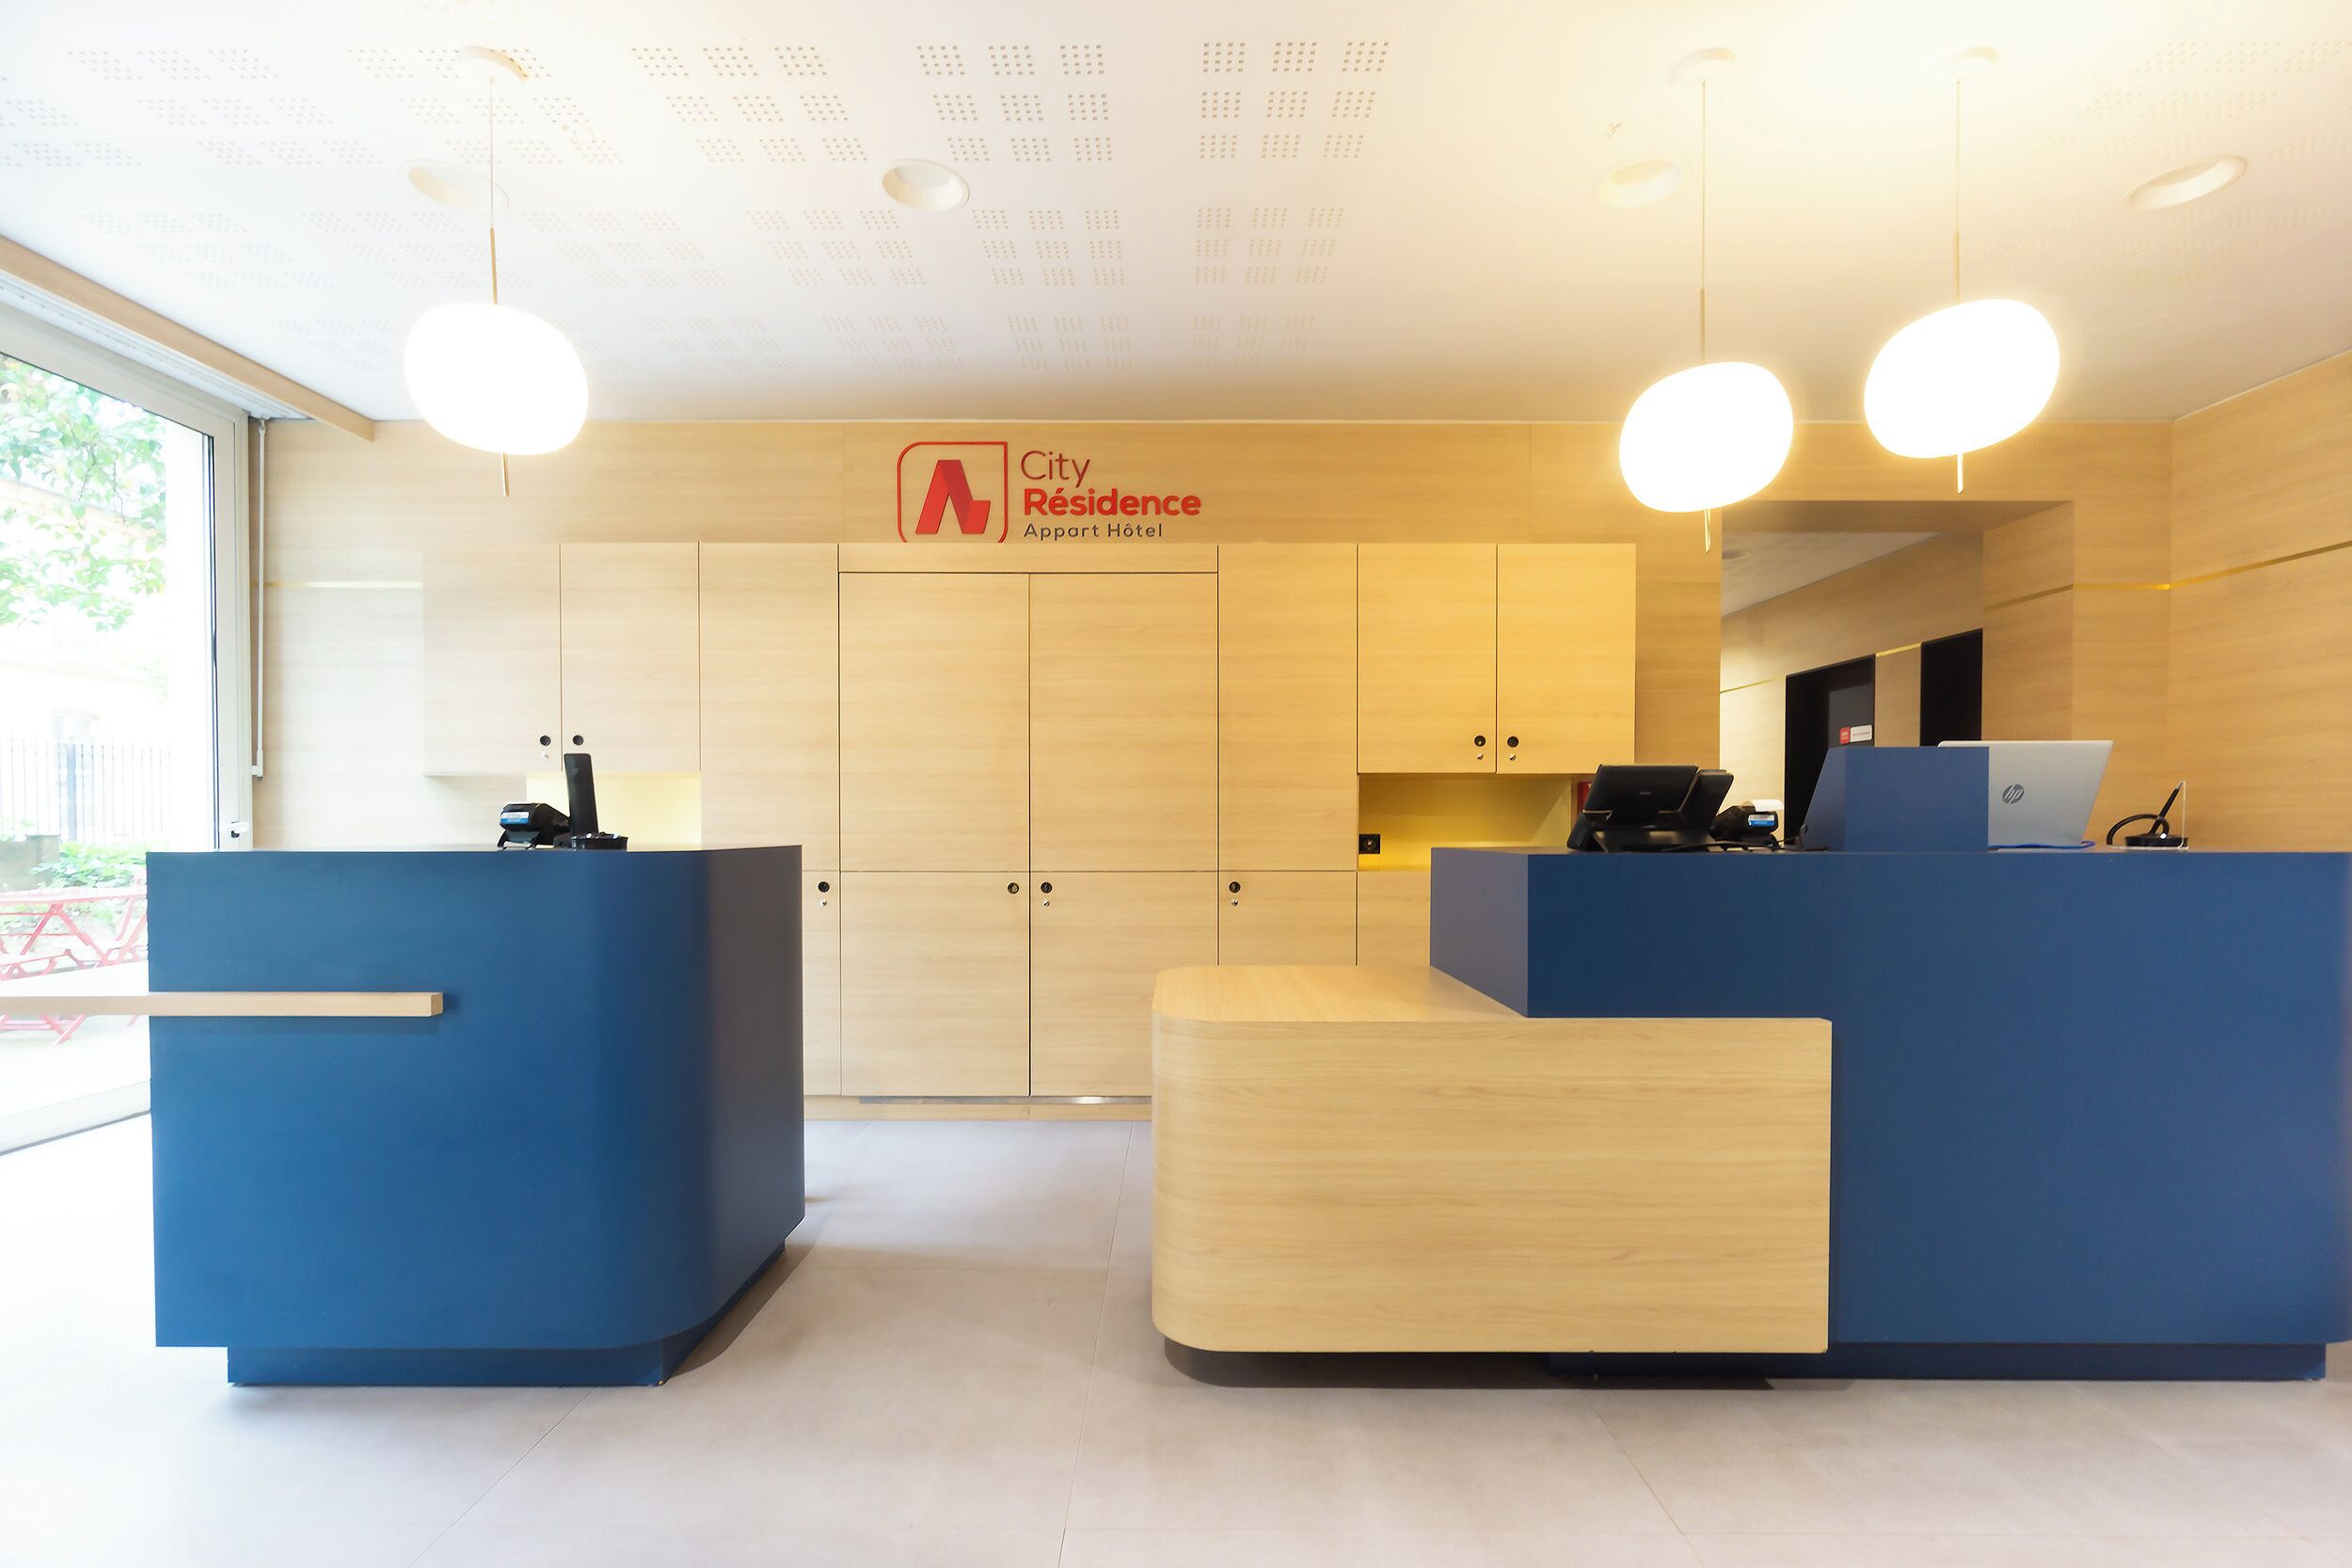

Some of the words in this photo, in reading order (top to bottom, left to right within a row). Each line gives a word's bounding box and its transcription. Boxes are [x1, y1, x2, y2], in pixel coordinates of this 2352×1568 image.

[1021, 451, 1090, 488] City
[1024, 487, 1201, 516] Résidence
[1024, 523, 1099, 541] Appart
[1107, 523, 1162, 538] Hôtel
[2003, 784, 2024, 804] hp
